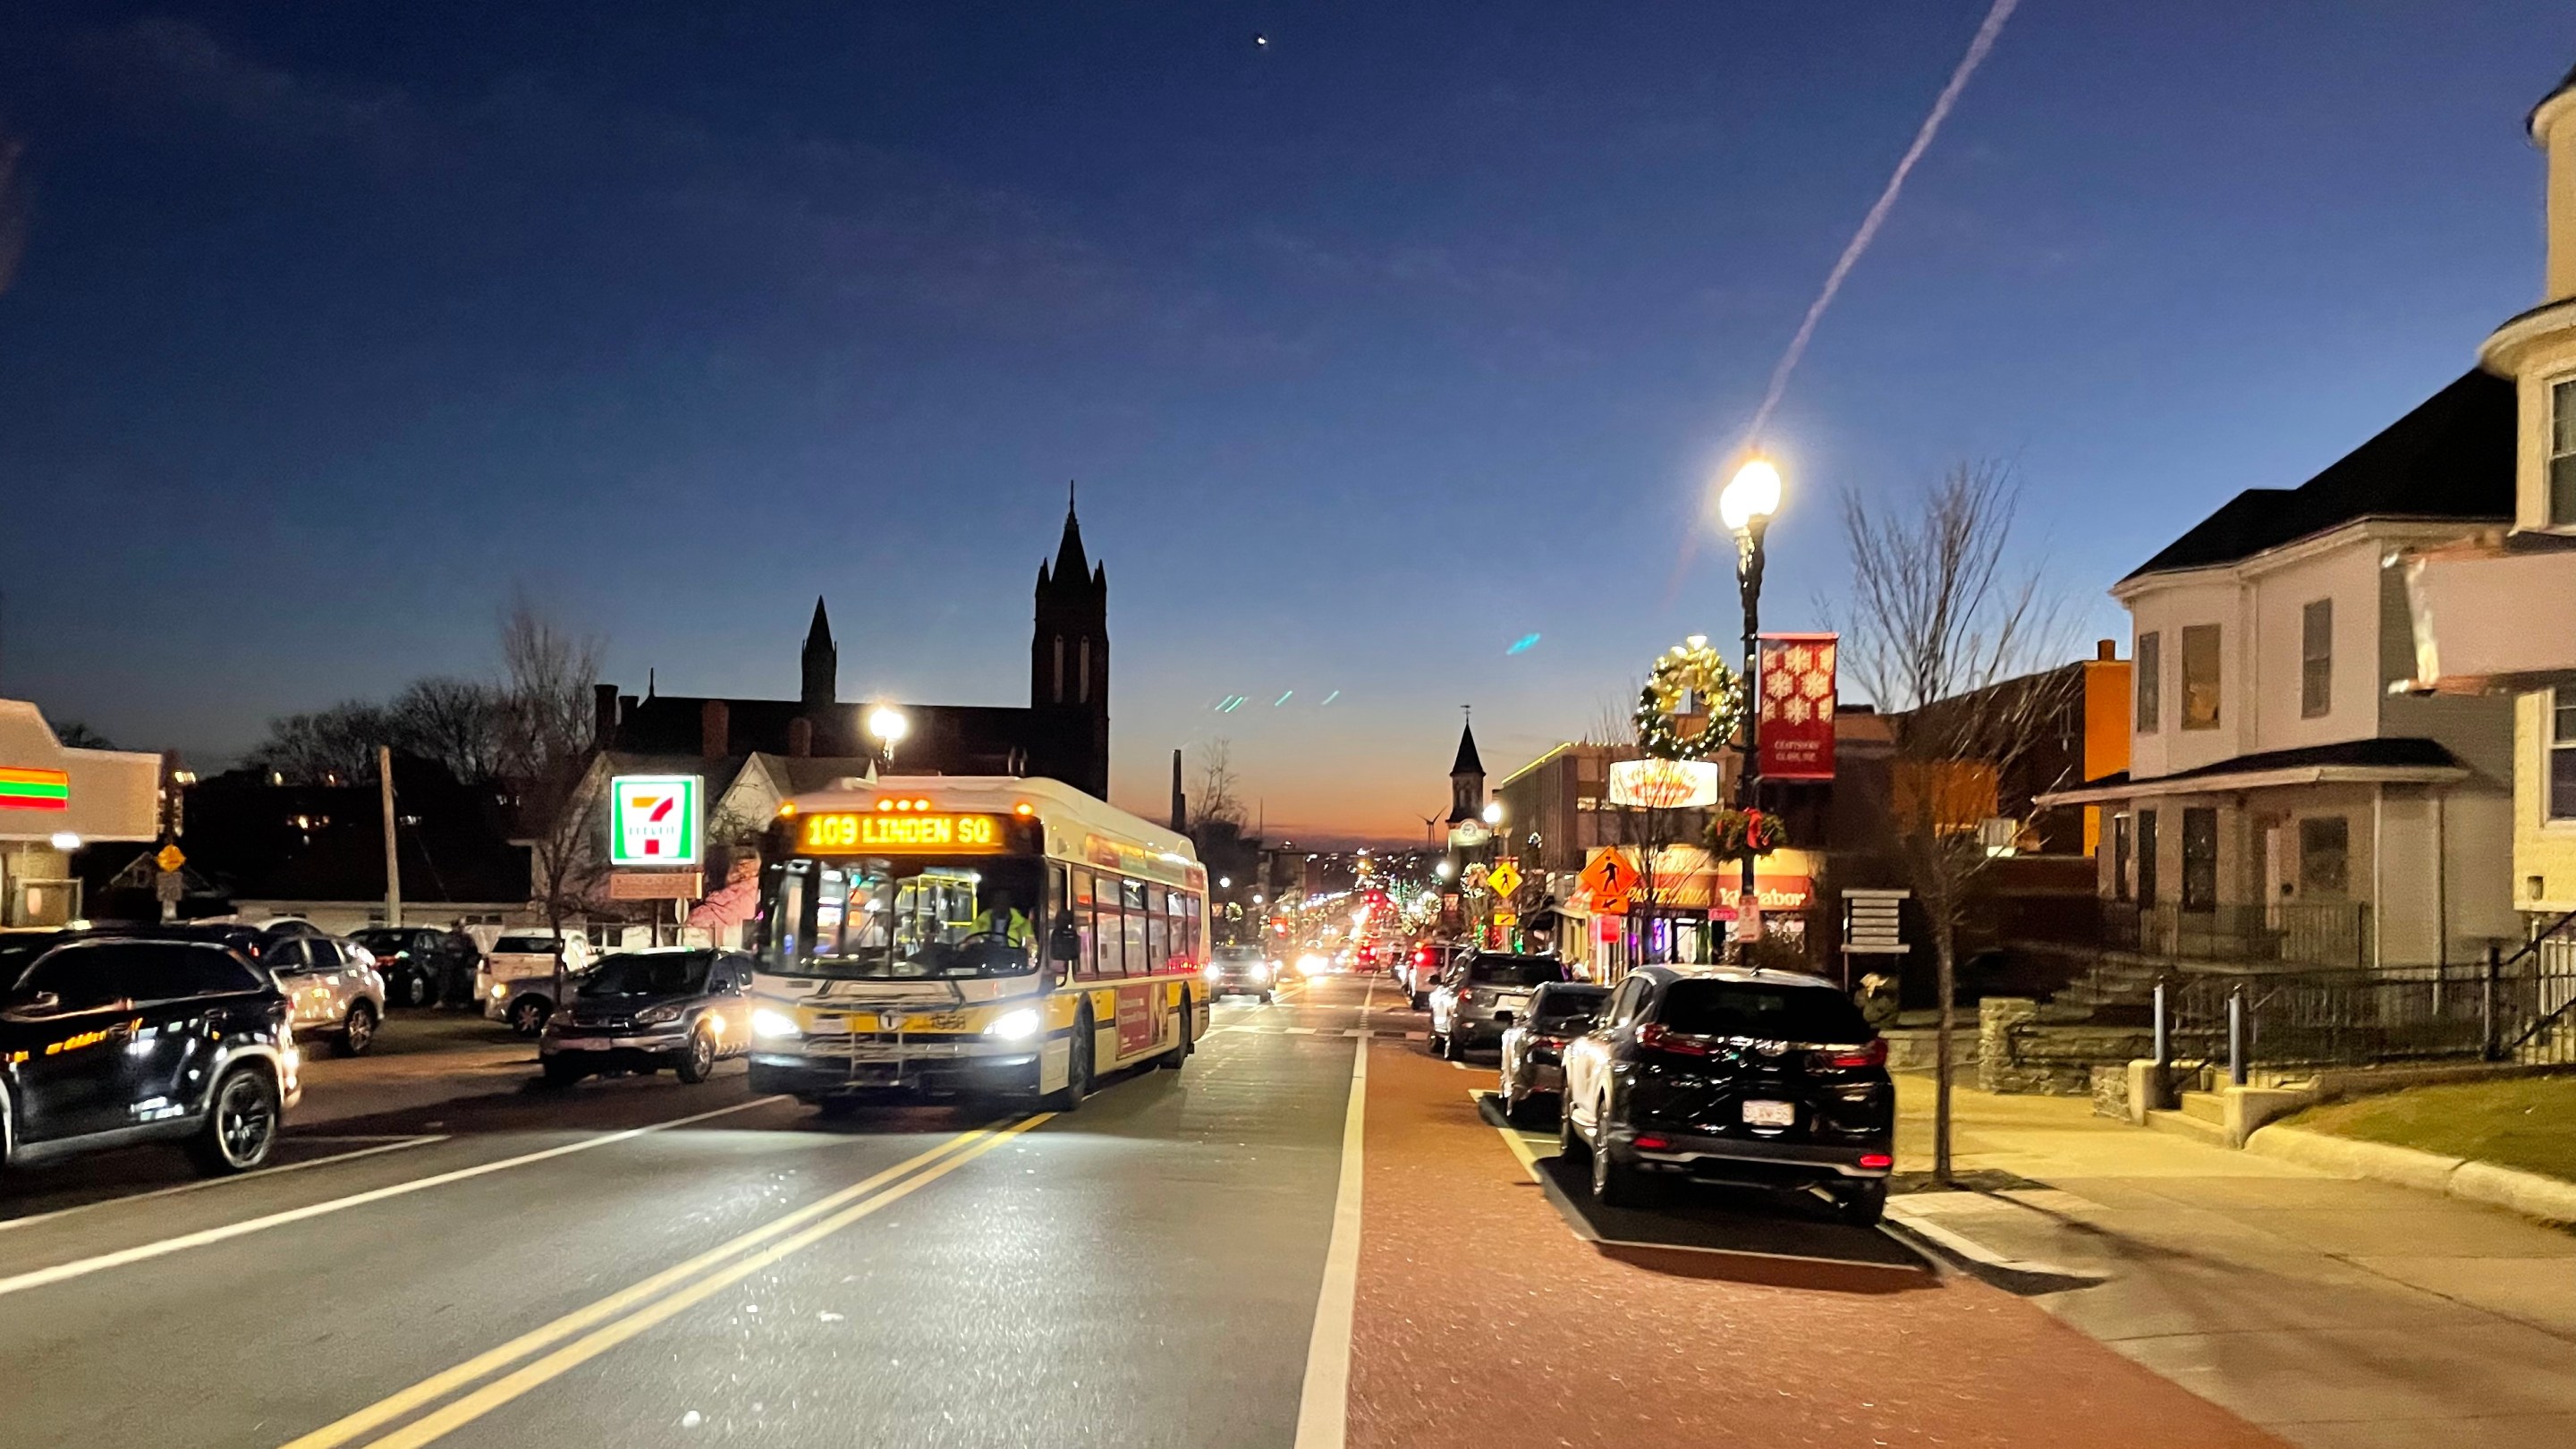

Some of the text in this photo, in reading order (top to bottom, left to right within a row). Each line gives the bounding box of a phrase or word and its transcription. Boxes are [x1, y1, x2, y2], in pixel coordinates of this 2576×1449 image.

[631, 795, 674, 822] 7
[809, 815, 991, 845] 109 LINDEN SQ
